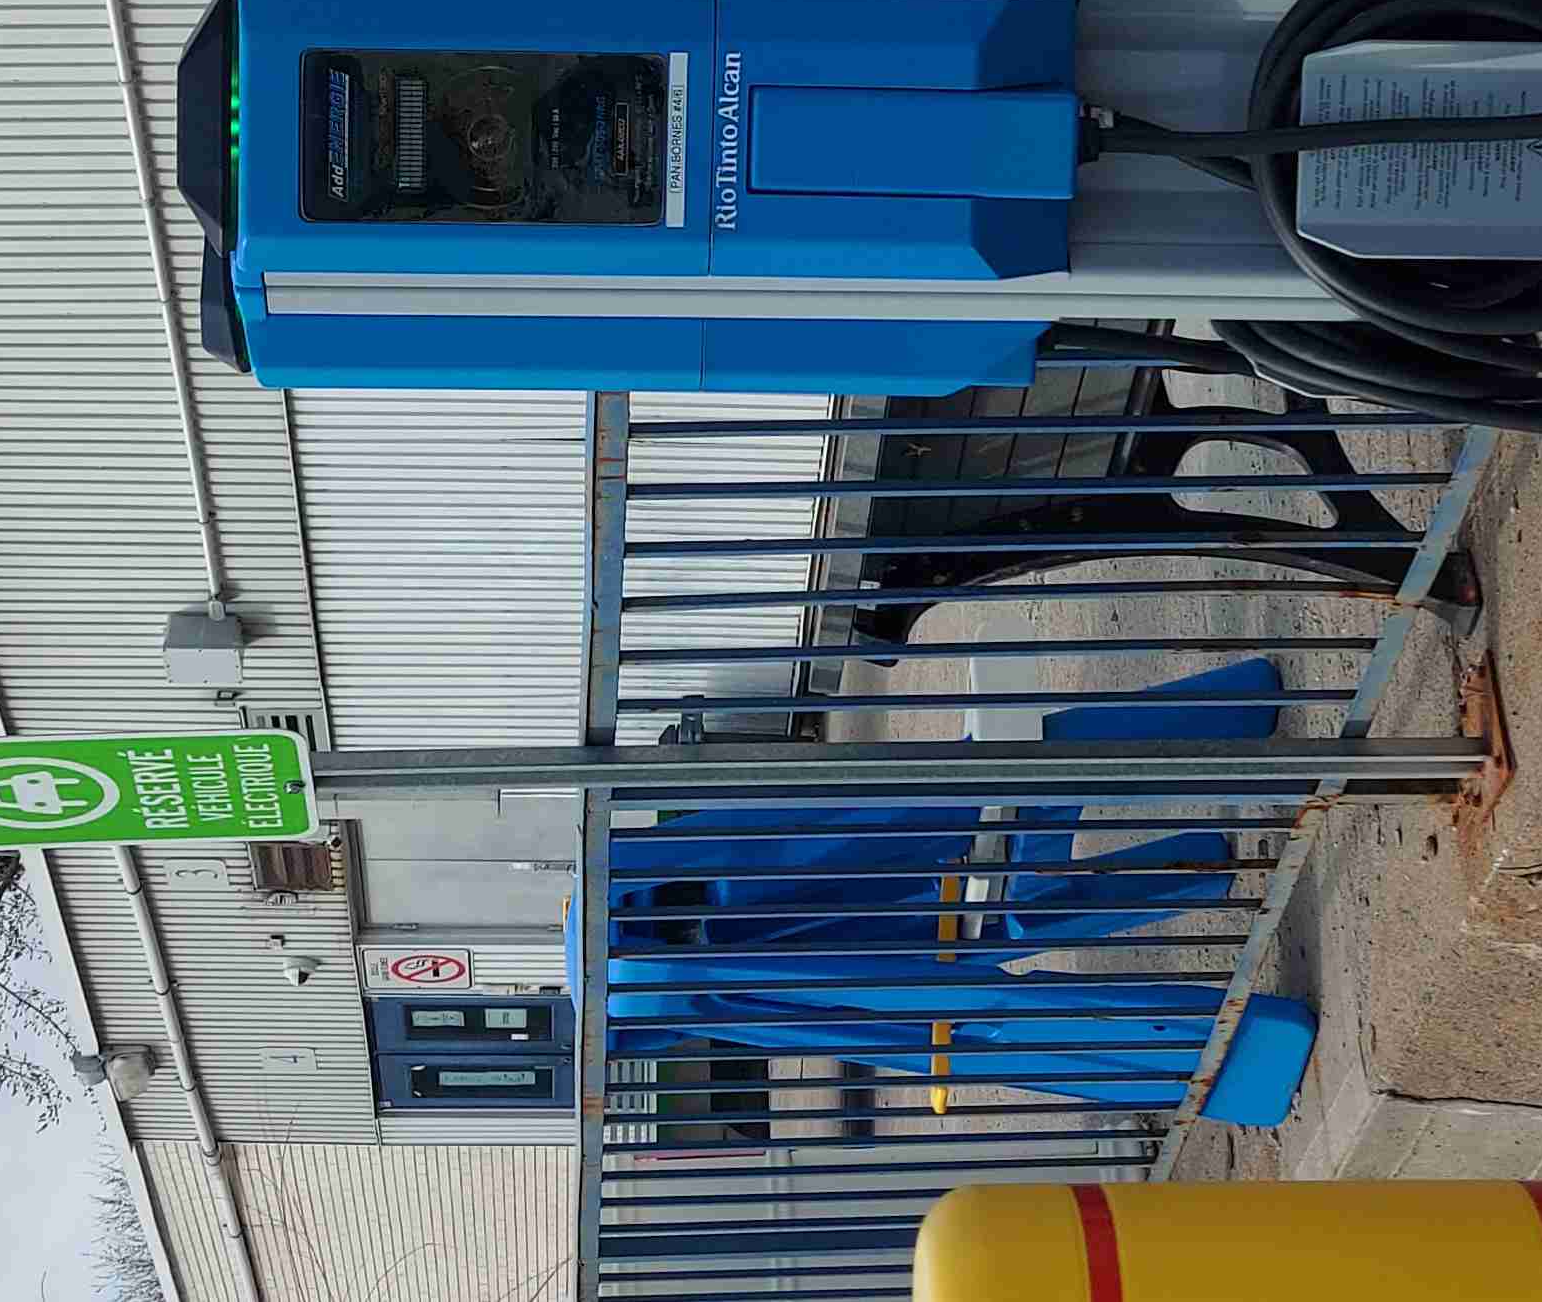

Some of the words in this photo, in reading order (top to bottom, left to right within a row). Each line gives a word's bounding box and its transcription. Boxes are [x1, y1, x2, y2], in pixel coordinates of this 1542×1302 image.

[717, 51, 741, 123] Alcan
[671, 115, 683, 163] BORNES
[716, 124, 739, 188] Tinto
[715, 188, 737, 230] Rio
[118, 748, 189, 828] RÉSERVÉ
[187, 754, 234, 822] VÉHICULE
[234, 744, 283, 827] ÉLECTRIQUE
[174, 868, 219, 880] 3
[269, 1055, 305, 1064] 4
